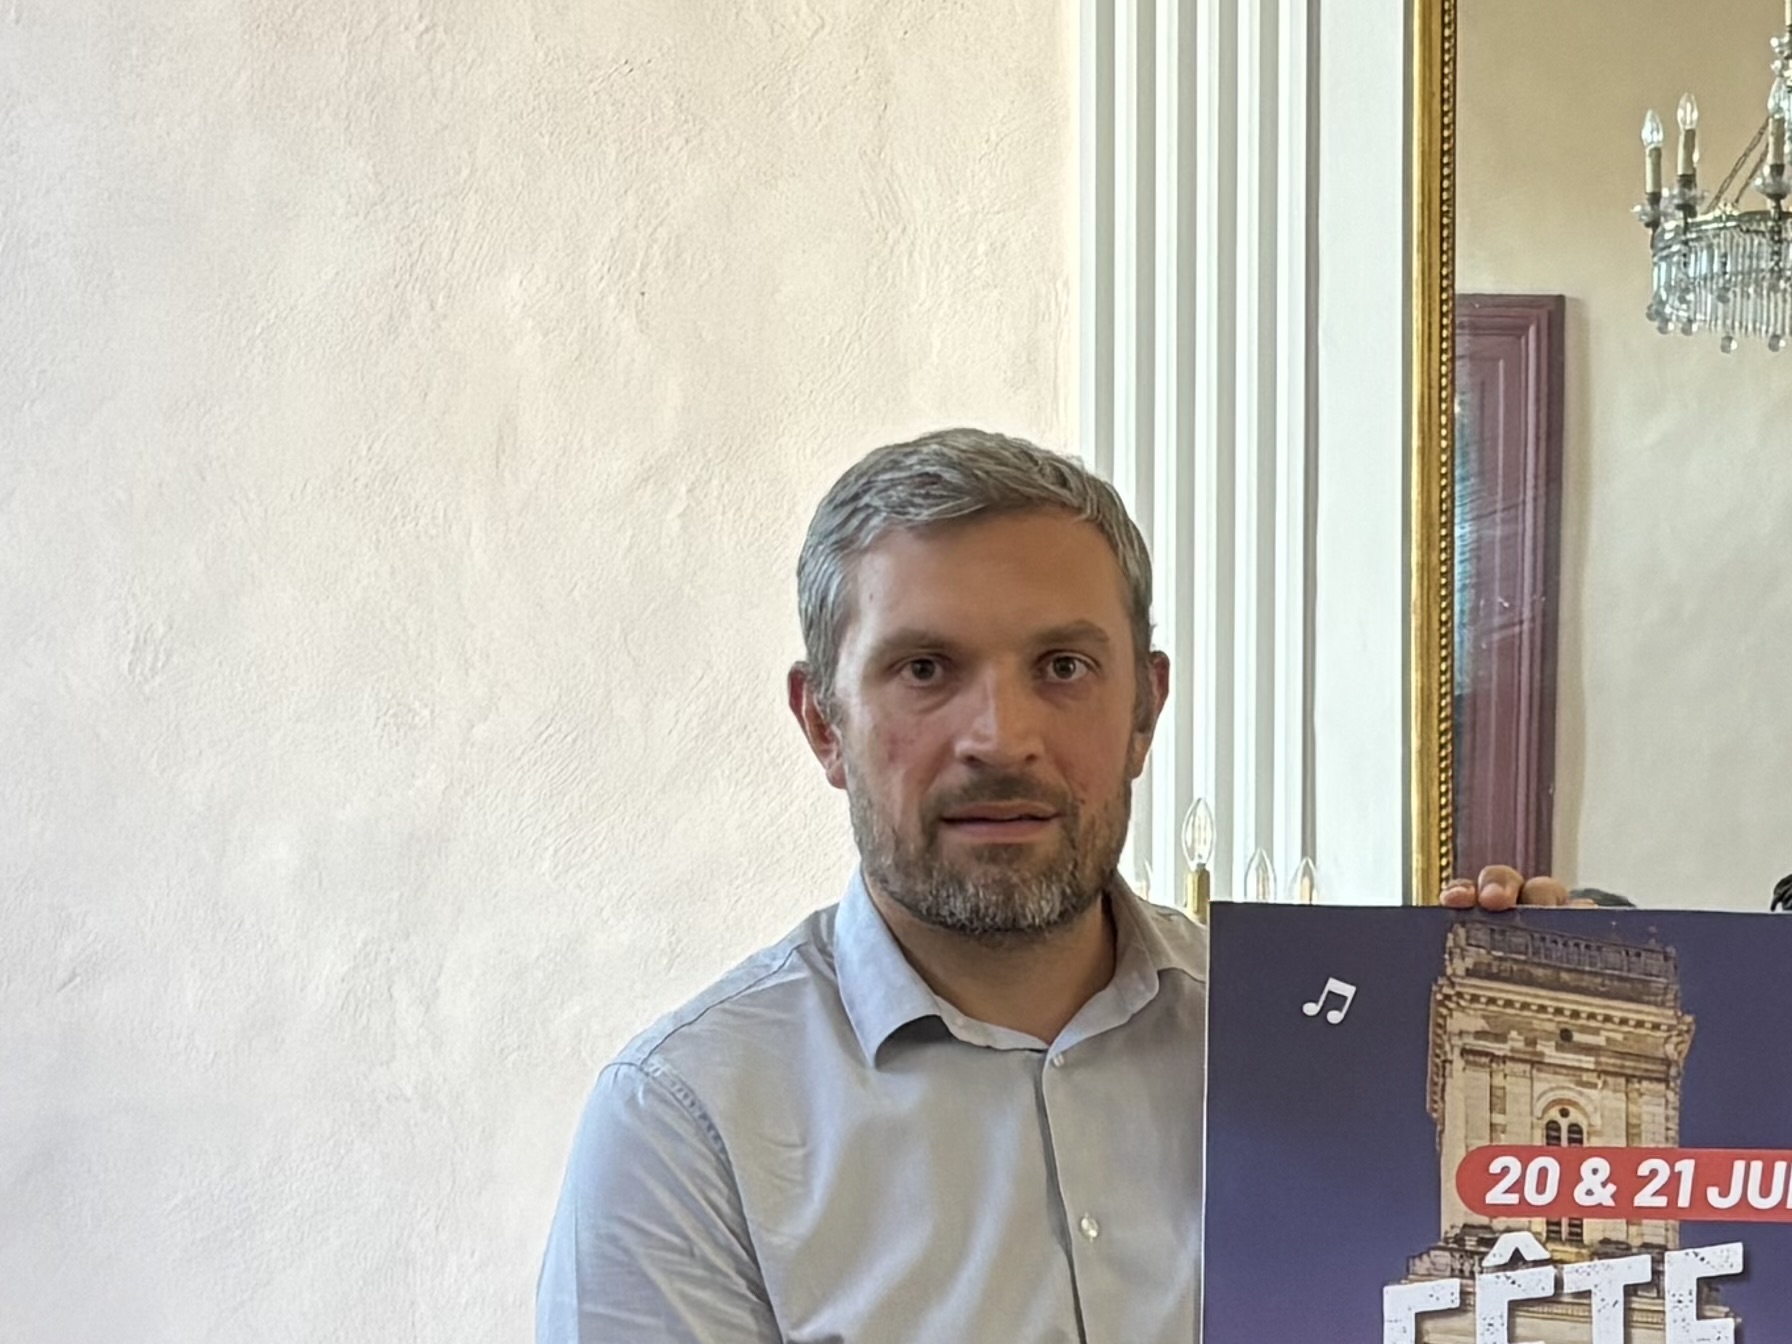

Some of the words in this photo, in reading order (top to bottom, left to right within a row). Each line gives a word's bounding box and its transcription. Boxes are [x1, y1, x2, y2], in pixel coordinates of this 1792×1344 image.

[1484, 1155, 1560, 1207] 20
[1573, 1158, 1617, 1207] &
[1633, 1158, 1695, 1209] 21
